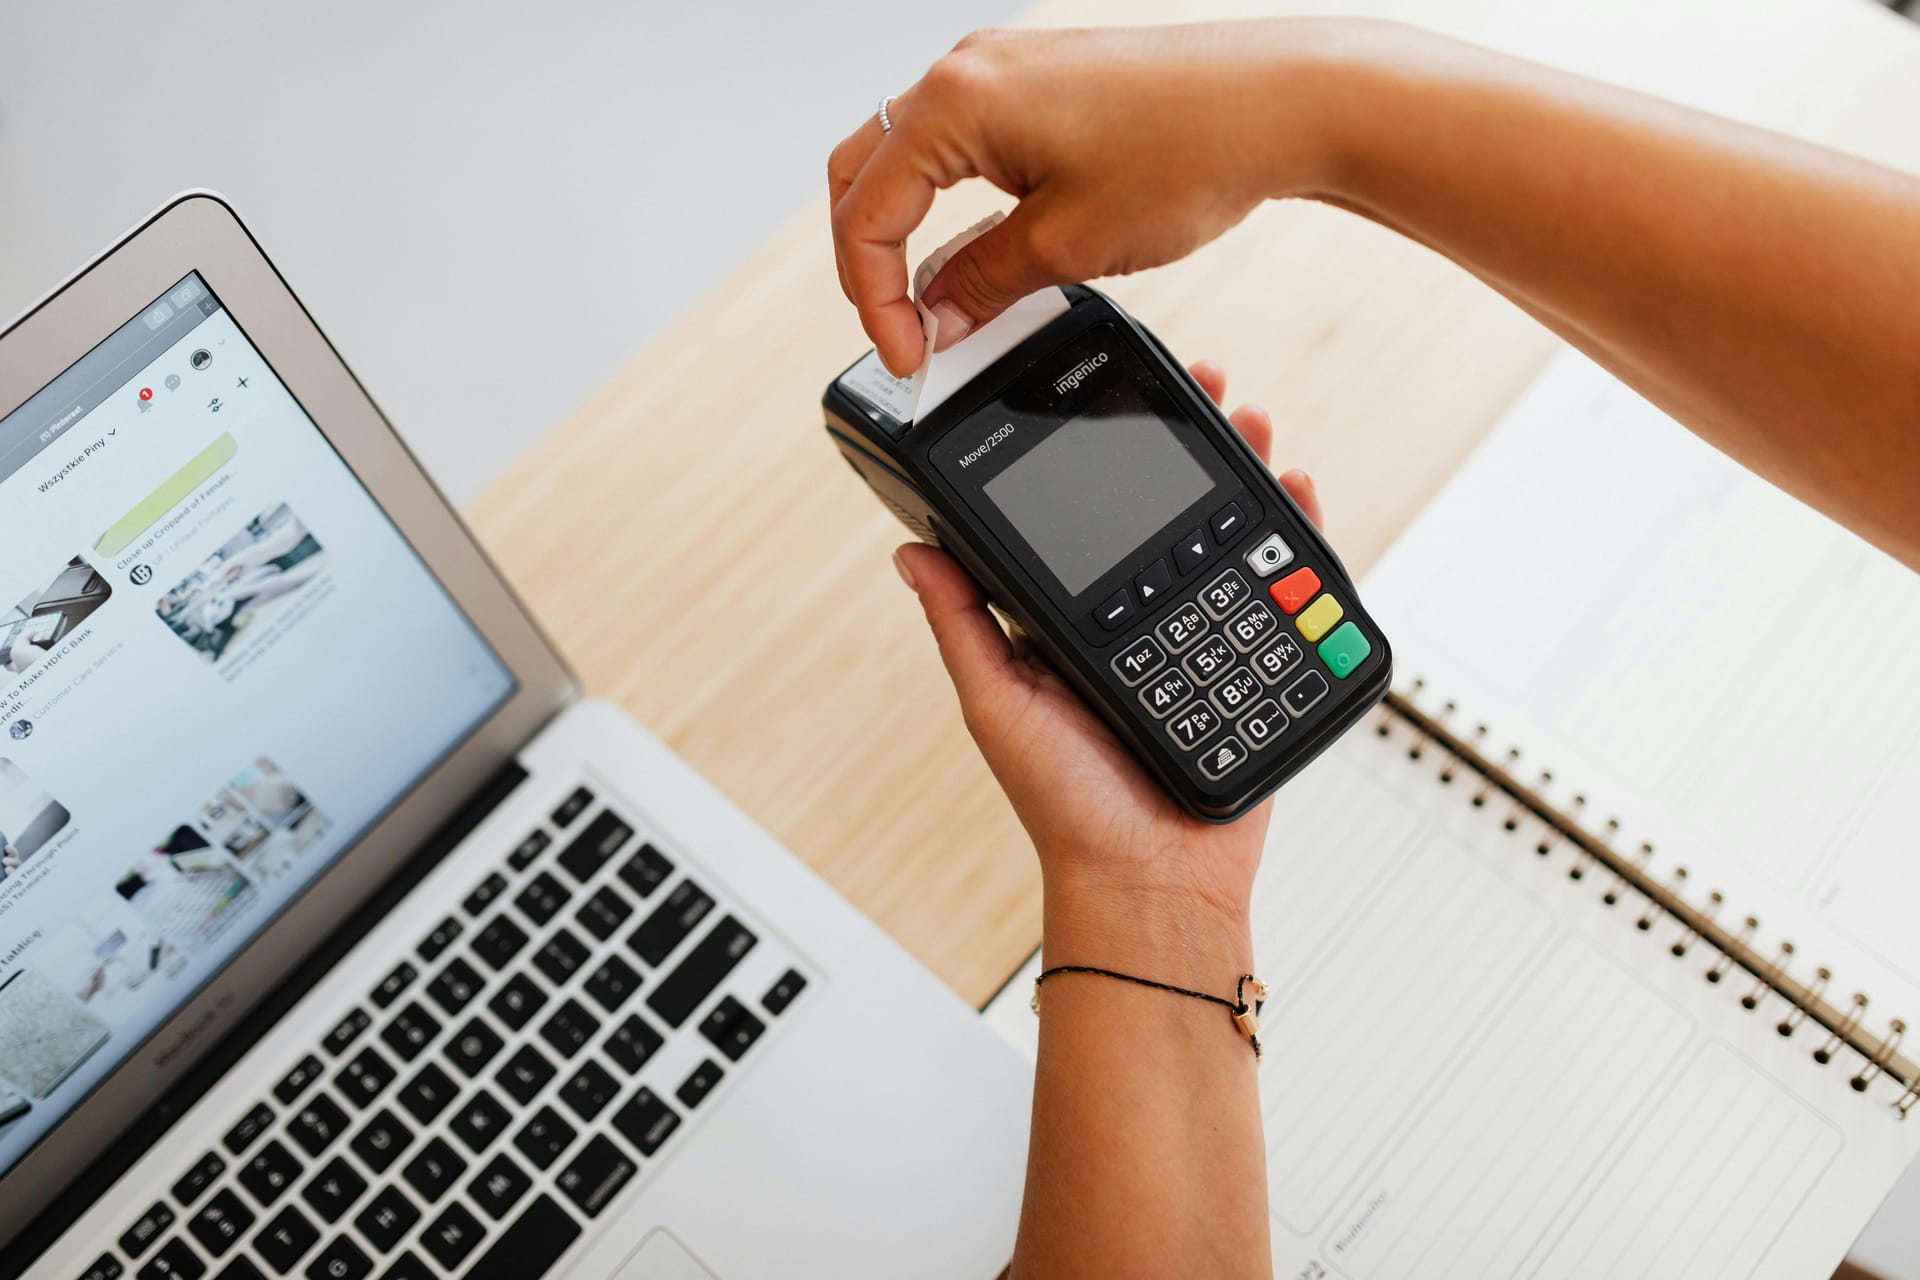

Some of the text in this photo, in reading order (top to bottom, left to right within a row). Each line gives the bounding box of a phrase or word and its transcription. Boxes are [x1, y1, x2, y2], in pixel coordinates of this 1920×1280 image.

[1053, 352, 1109, 395] ingenico
[50, 405, 82, 433] Pinterest
[958, 423, 1015, 469] Move/2500
[38, 438, 105, 493] Wszystkie Piny
[116, 547, 142, 570] Close
[142, 538, 154, 550] up
[153, 507, 191, 539] Cropped
[1210, 588, 1229, 608] 3
[1168, 621, 1188, 642] 2
[1236, 621, 1255, 640] 6
[7, 690, 20, 700] To
[19, 669, 45, 691] Make
[43, 646, 70, 671] HDFC
[69, 628, 93, 649] Bank
[1125, 655, 1142, 672] 1
[1196, 652, 1216, 672] 5
[1262, 653, 1282, 673] 9
[1155, 687, 1171, 706] 4
[1222, 685, 1241, 705] 8
[1176, 718, 1194, 740] 7
[1249, 718, 1268, 738] 0
